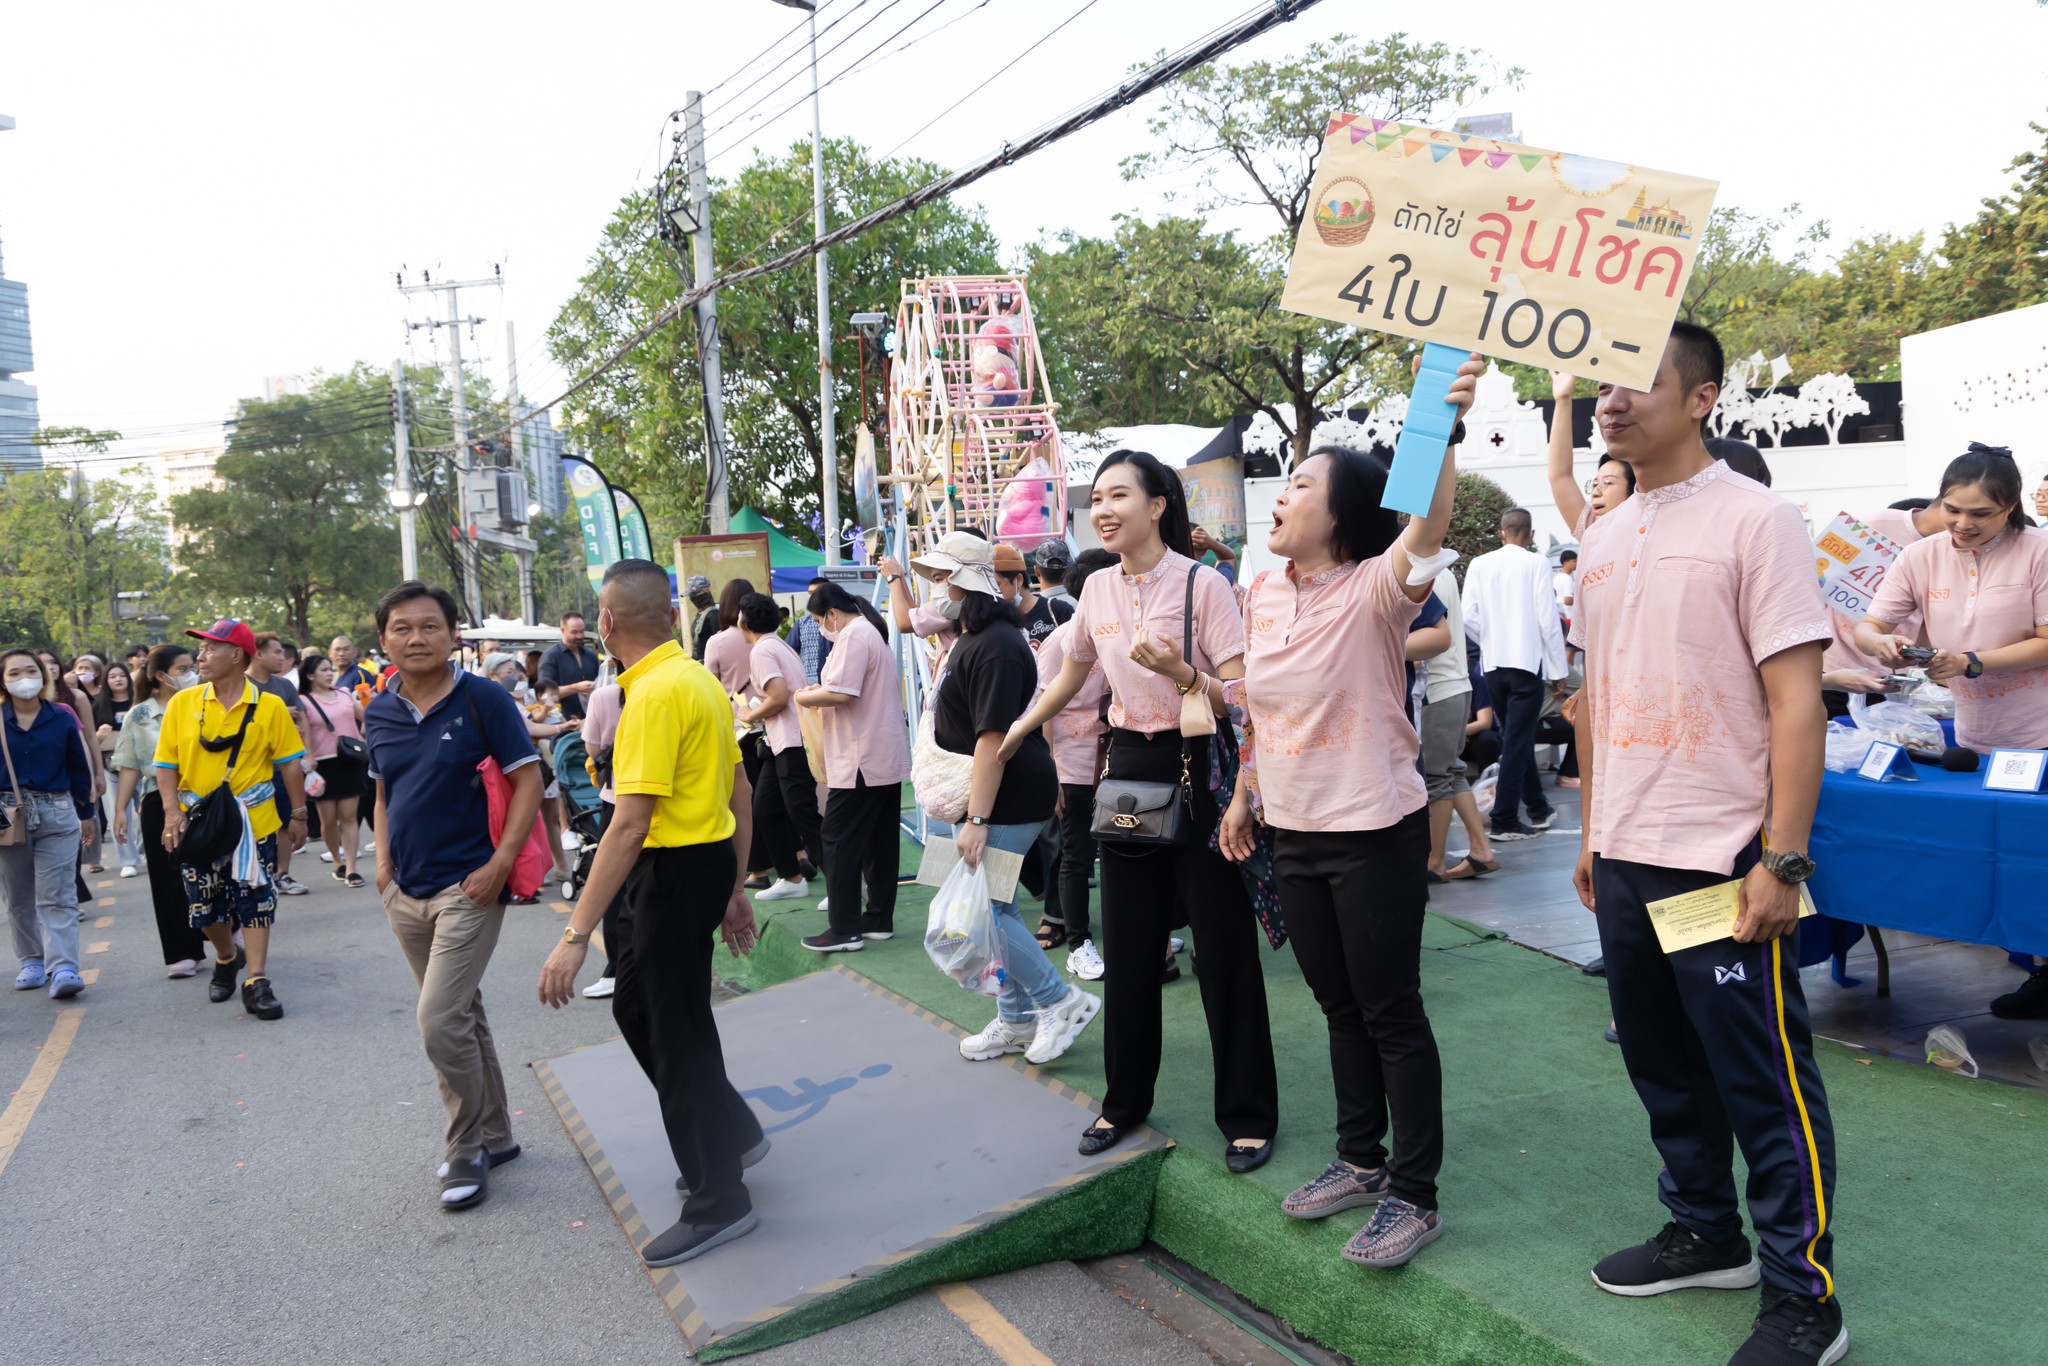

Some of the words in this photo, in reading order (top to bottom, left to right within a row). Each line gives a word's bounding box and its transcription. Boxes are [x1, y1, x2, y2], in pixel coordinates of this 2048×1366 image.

[1393, 201, 1465, 239] ตักไข่
[1469, 195, 1684, 298] ลุ้นโชค
[1337, 253, 1448, 328] 4ใบ
[1477, 289, 1641, 367] 100.-
[1820, 536, 1856, 561] ตักไข่
